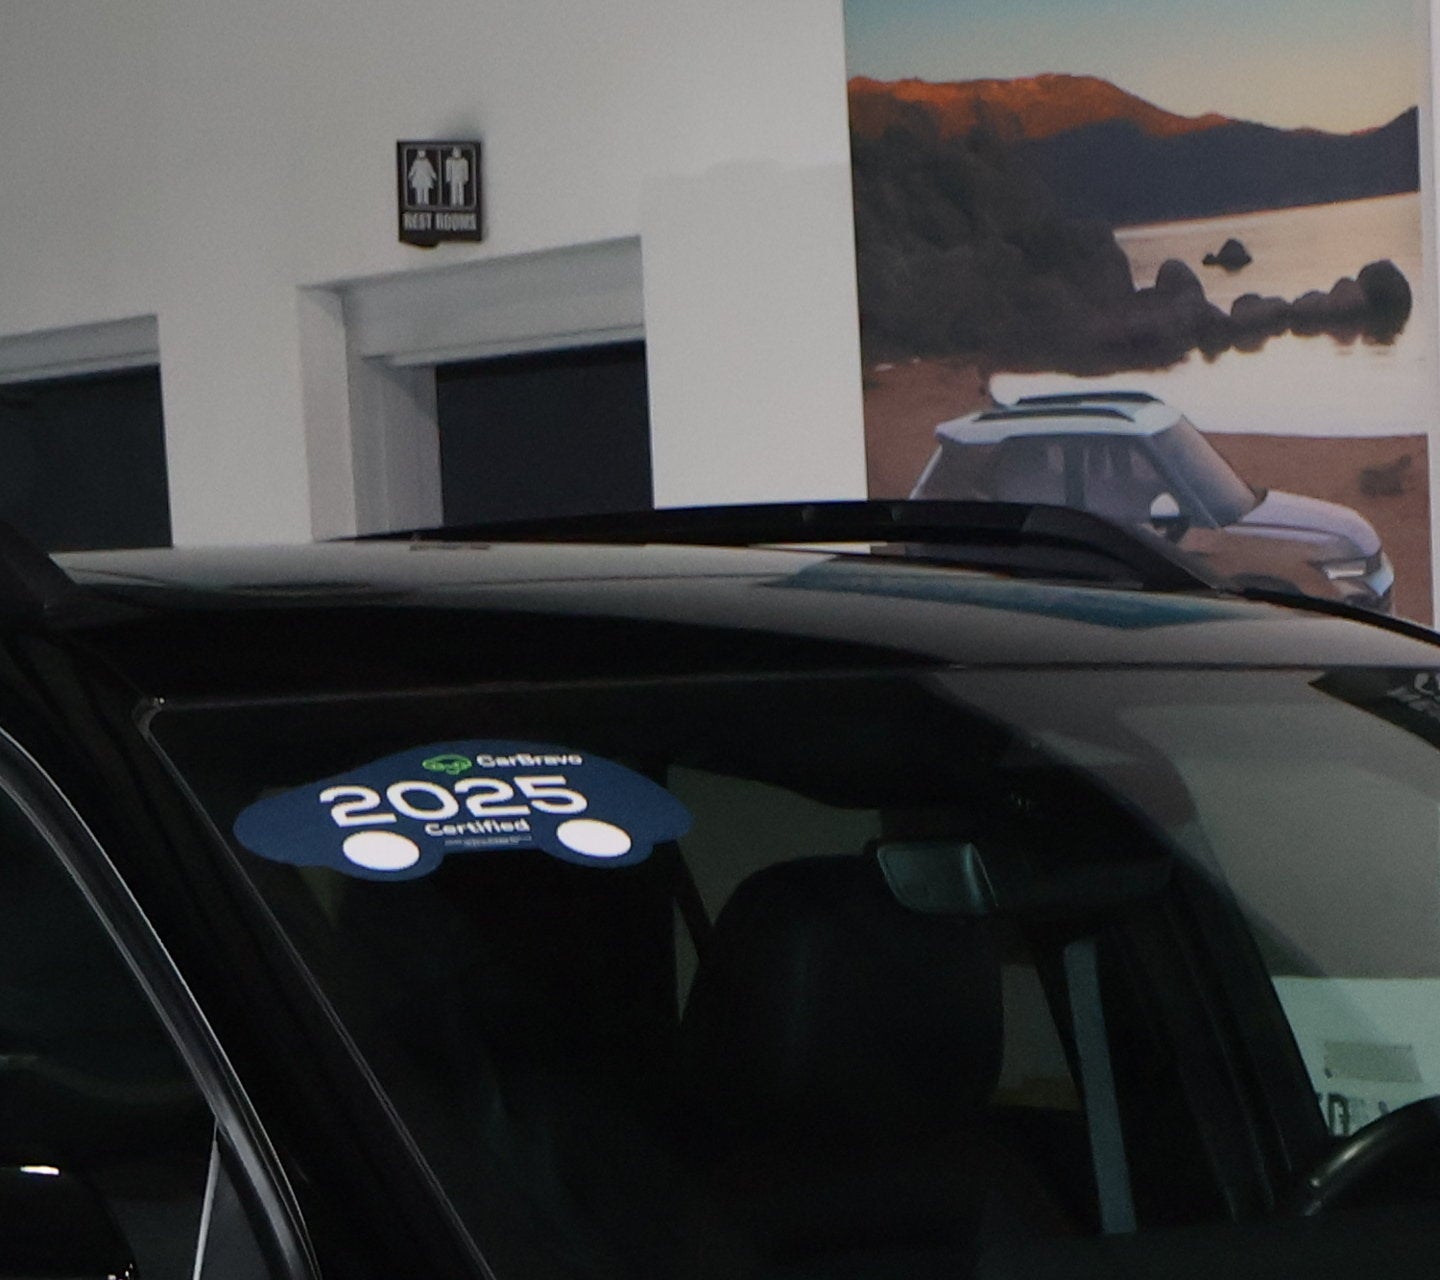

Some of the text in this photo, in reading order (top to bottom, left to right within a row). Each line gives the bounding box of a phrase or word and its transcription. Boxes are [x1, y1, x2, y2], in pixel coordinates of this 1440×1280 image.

[476, 753, 583, 768] CarBravo
[319, 775, 588, 828] 2025
[425, 818, 531, 837] Certified
